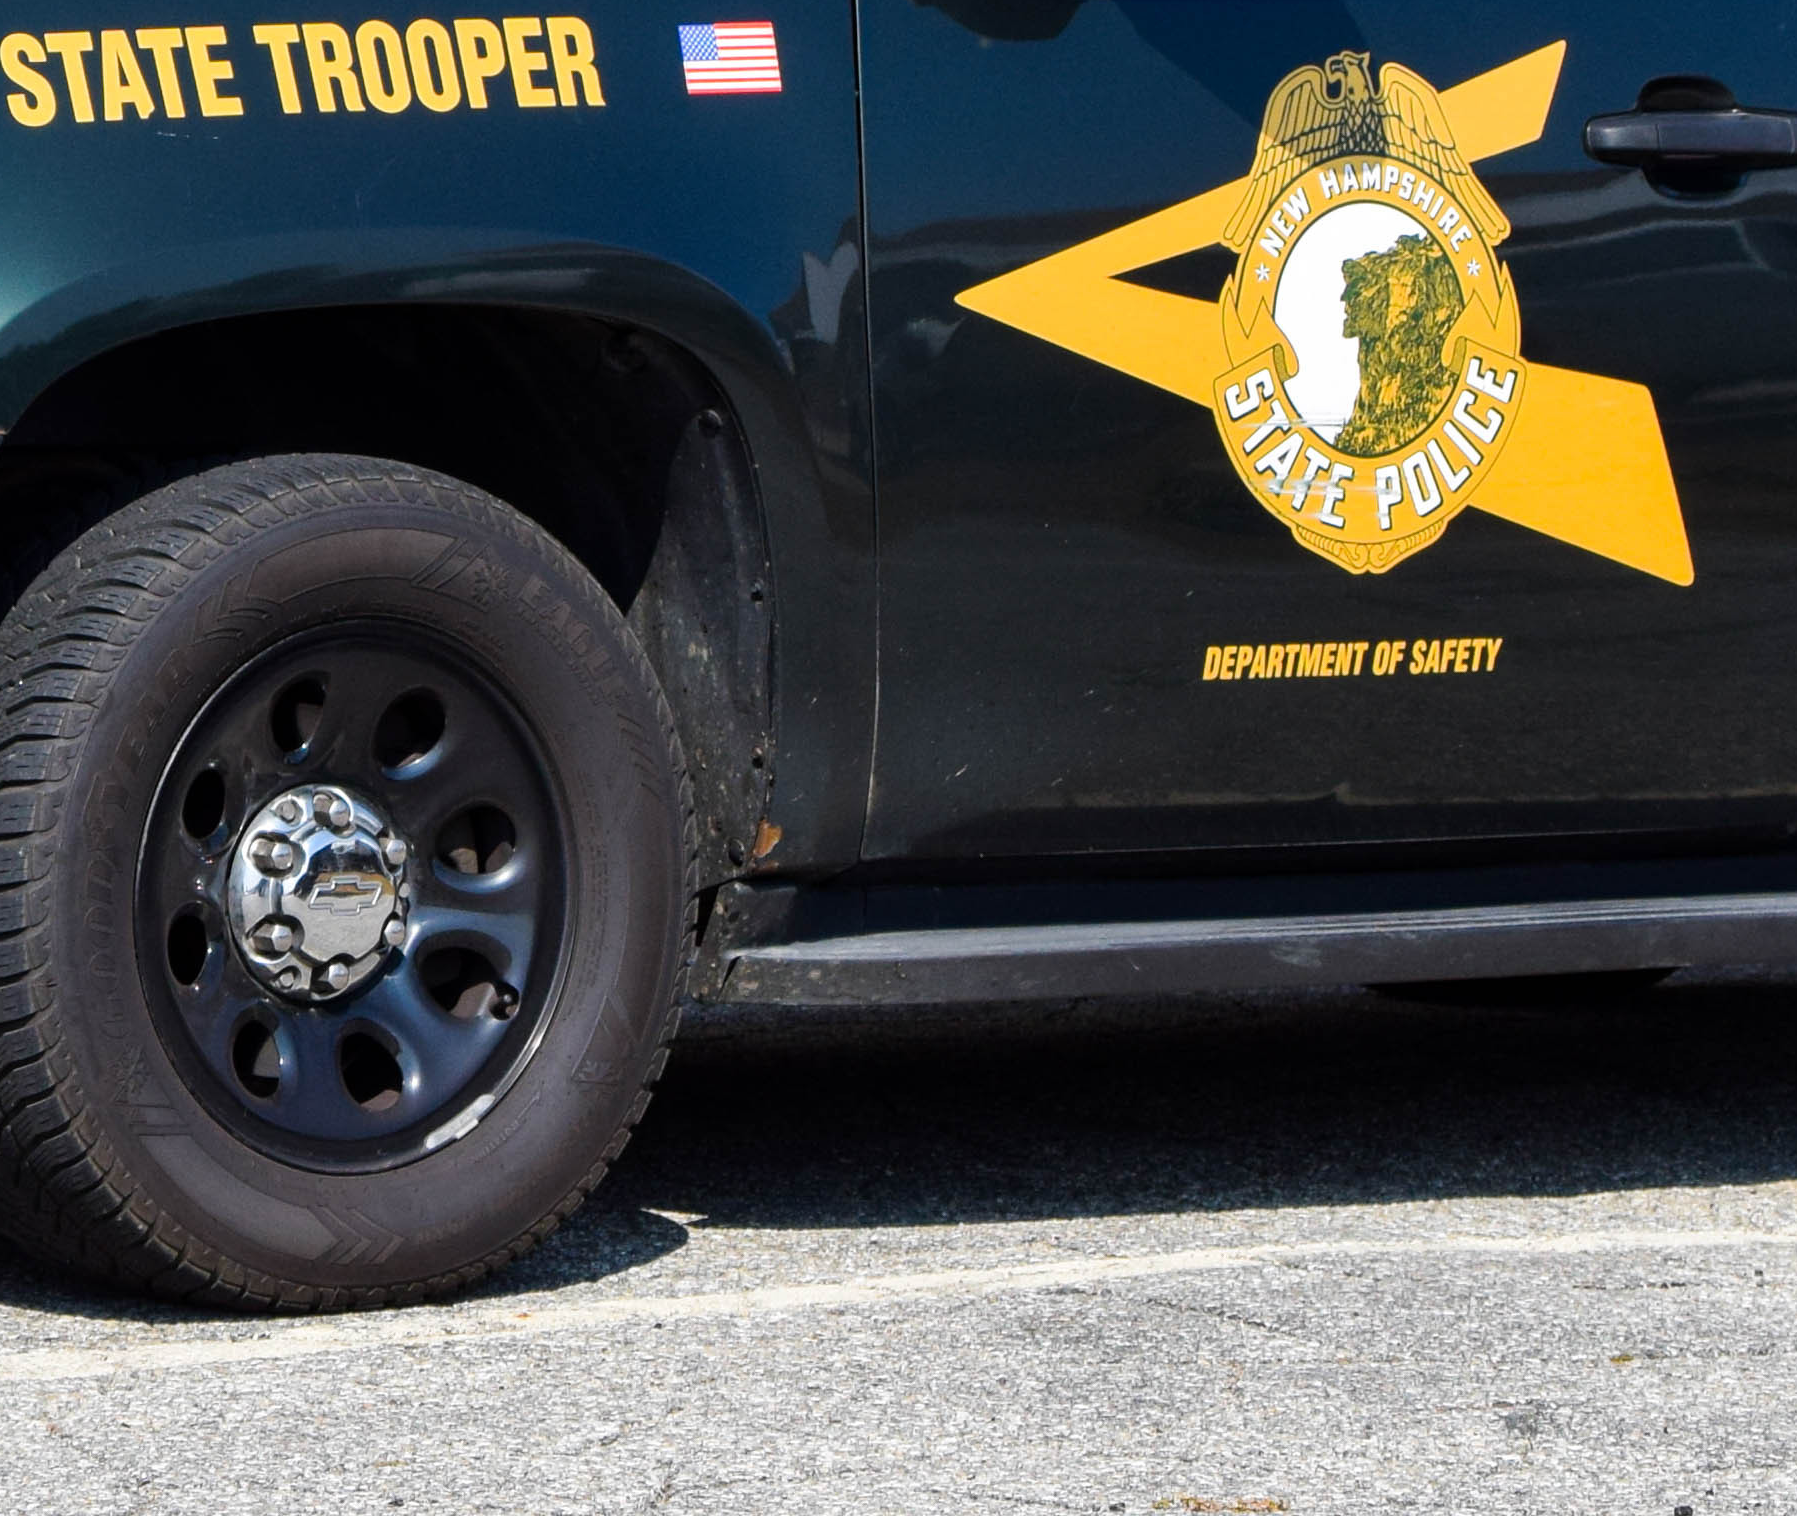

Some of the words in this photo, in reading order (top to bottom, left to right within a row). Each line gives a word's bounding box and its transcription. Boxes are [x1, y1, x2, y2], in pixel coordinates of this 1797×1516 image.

[0, 25, 244, 127] STATE
[254, 16, 605, 114] TROOPER
[1261, 195, 1312, 259] NEW
[1319, 161, 1471, 254] HAMPSHIRE
[1224, 367, 1354, 531] STATE
[1375, 356, 1516, 531] POLICE
[1203, 642, 1369, 681] DEPARTMENT
[1373, 641, 1405, 675] OF
[1409, 638, 1503, 675] SAFETY
